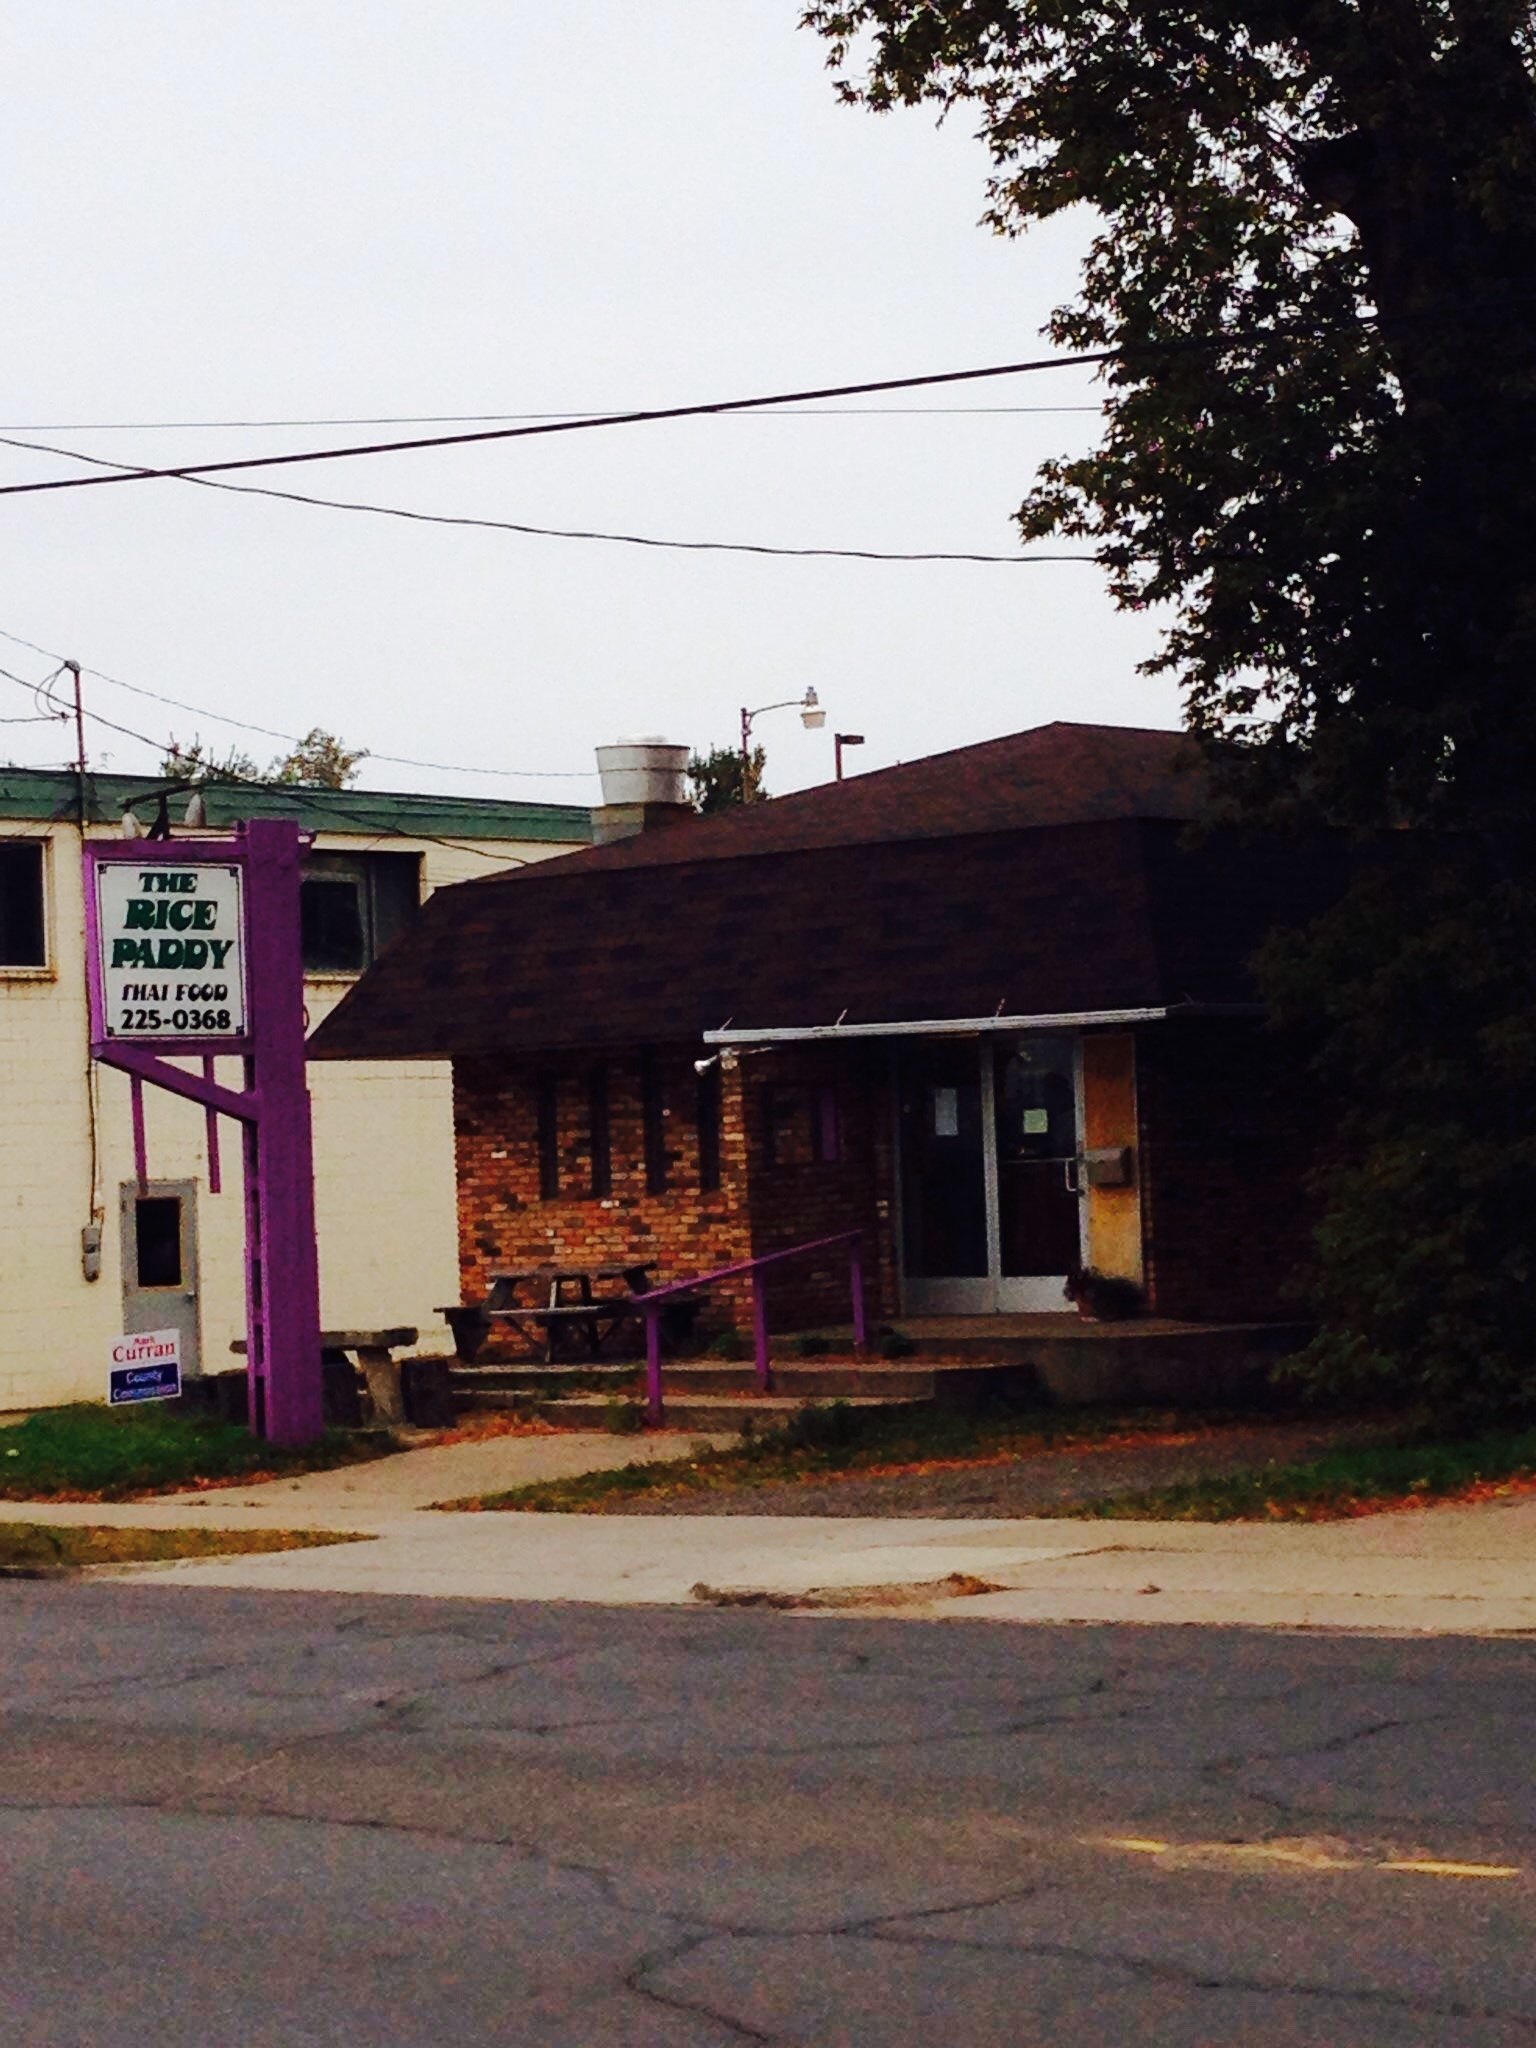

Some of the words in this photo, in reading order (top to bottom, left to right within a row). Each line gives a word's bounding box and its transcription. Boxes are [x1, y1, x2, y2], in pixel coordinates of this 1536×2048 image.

[139, 872, 198, 893] THE
[123, 899, 218, 931] RICE
[110, 938, 235, 969] PADDY
[121, 984, 169, 1001] THAI
[175, 984, 228, 1001] FOOD
[121, 1009, 231, 1030] 225-0368
[112, 1343, 176, 1363] Curran
